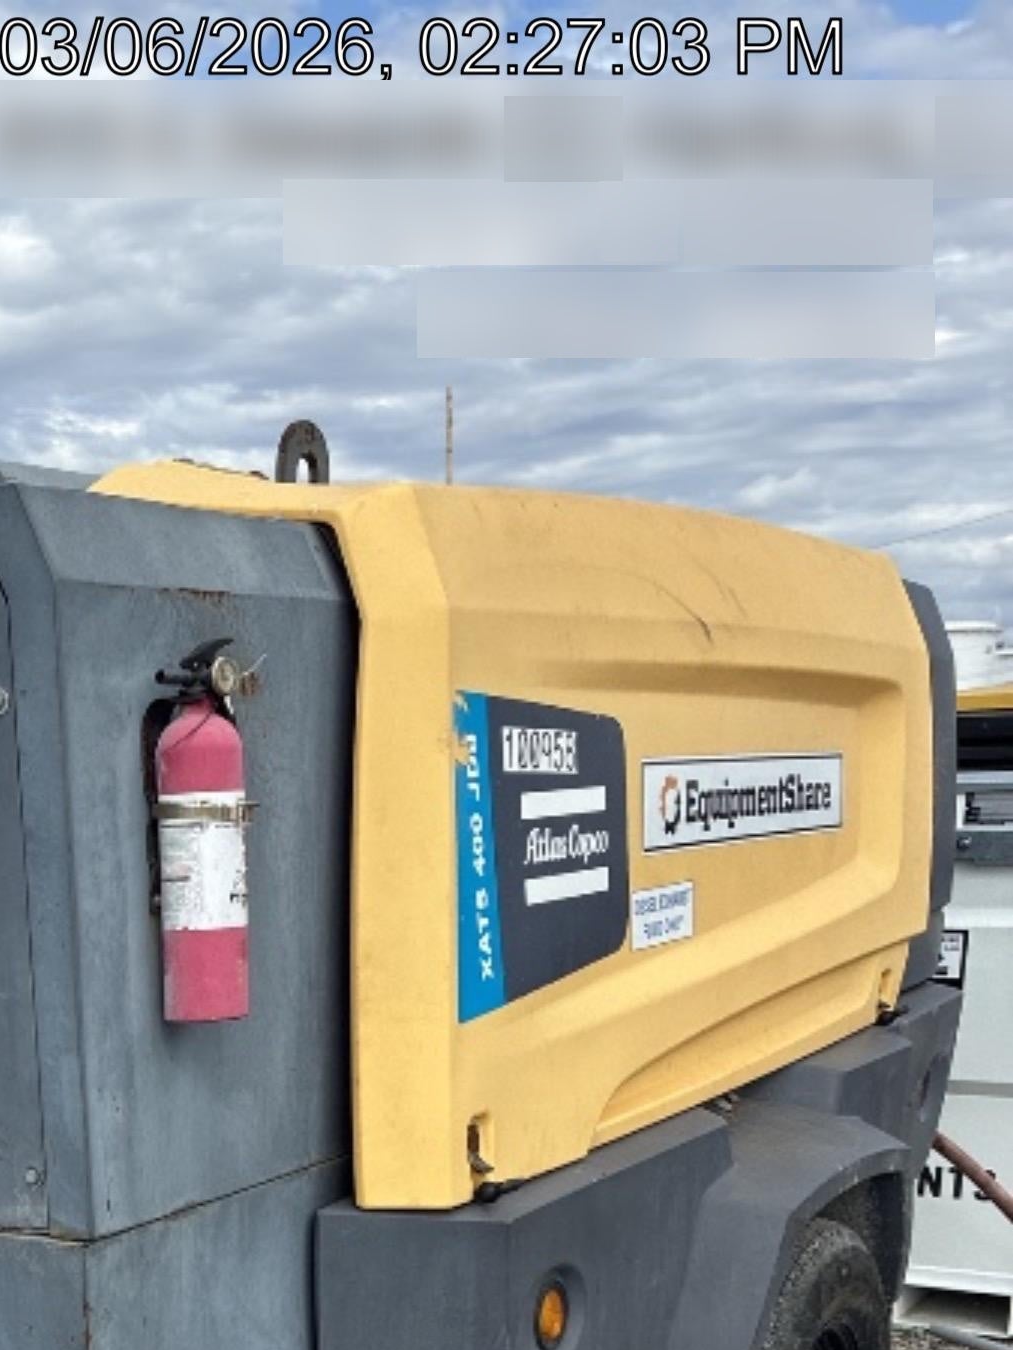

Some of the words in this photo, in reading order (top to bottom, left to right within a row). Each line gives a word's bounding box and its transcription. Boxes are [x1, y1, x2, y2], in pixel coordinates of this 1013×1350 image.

[685, 773, 832, 832] EquipmentShare
[470, 812, 487, 877] 400
[523, 827, 567, 865] Atlas
[568, 823, 610, 865] Copco
[476, 888, 495, 981] XATS
